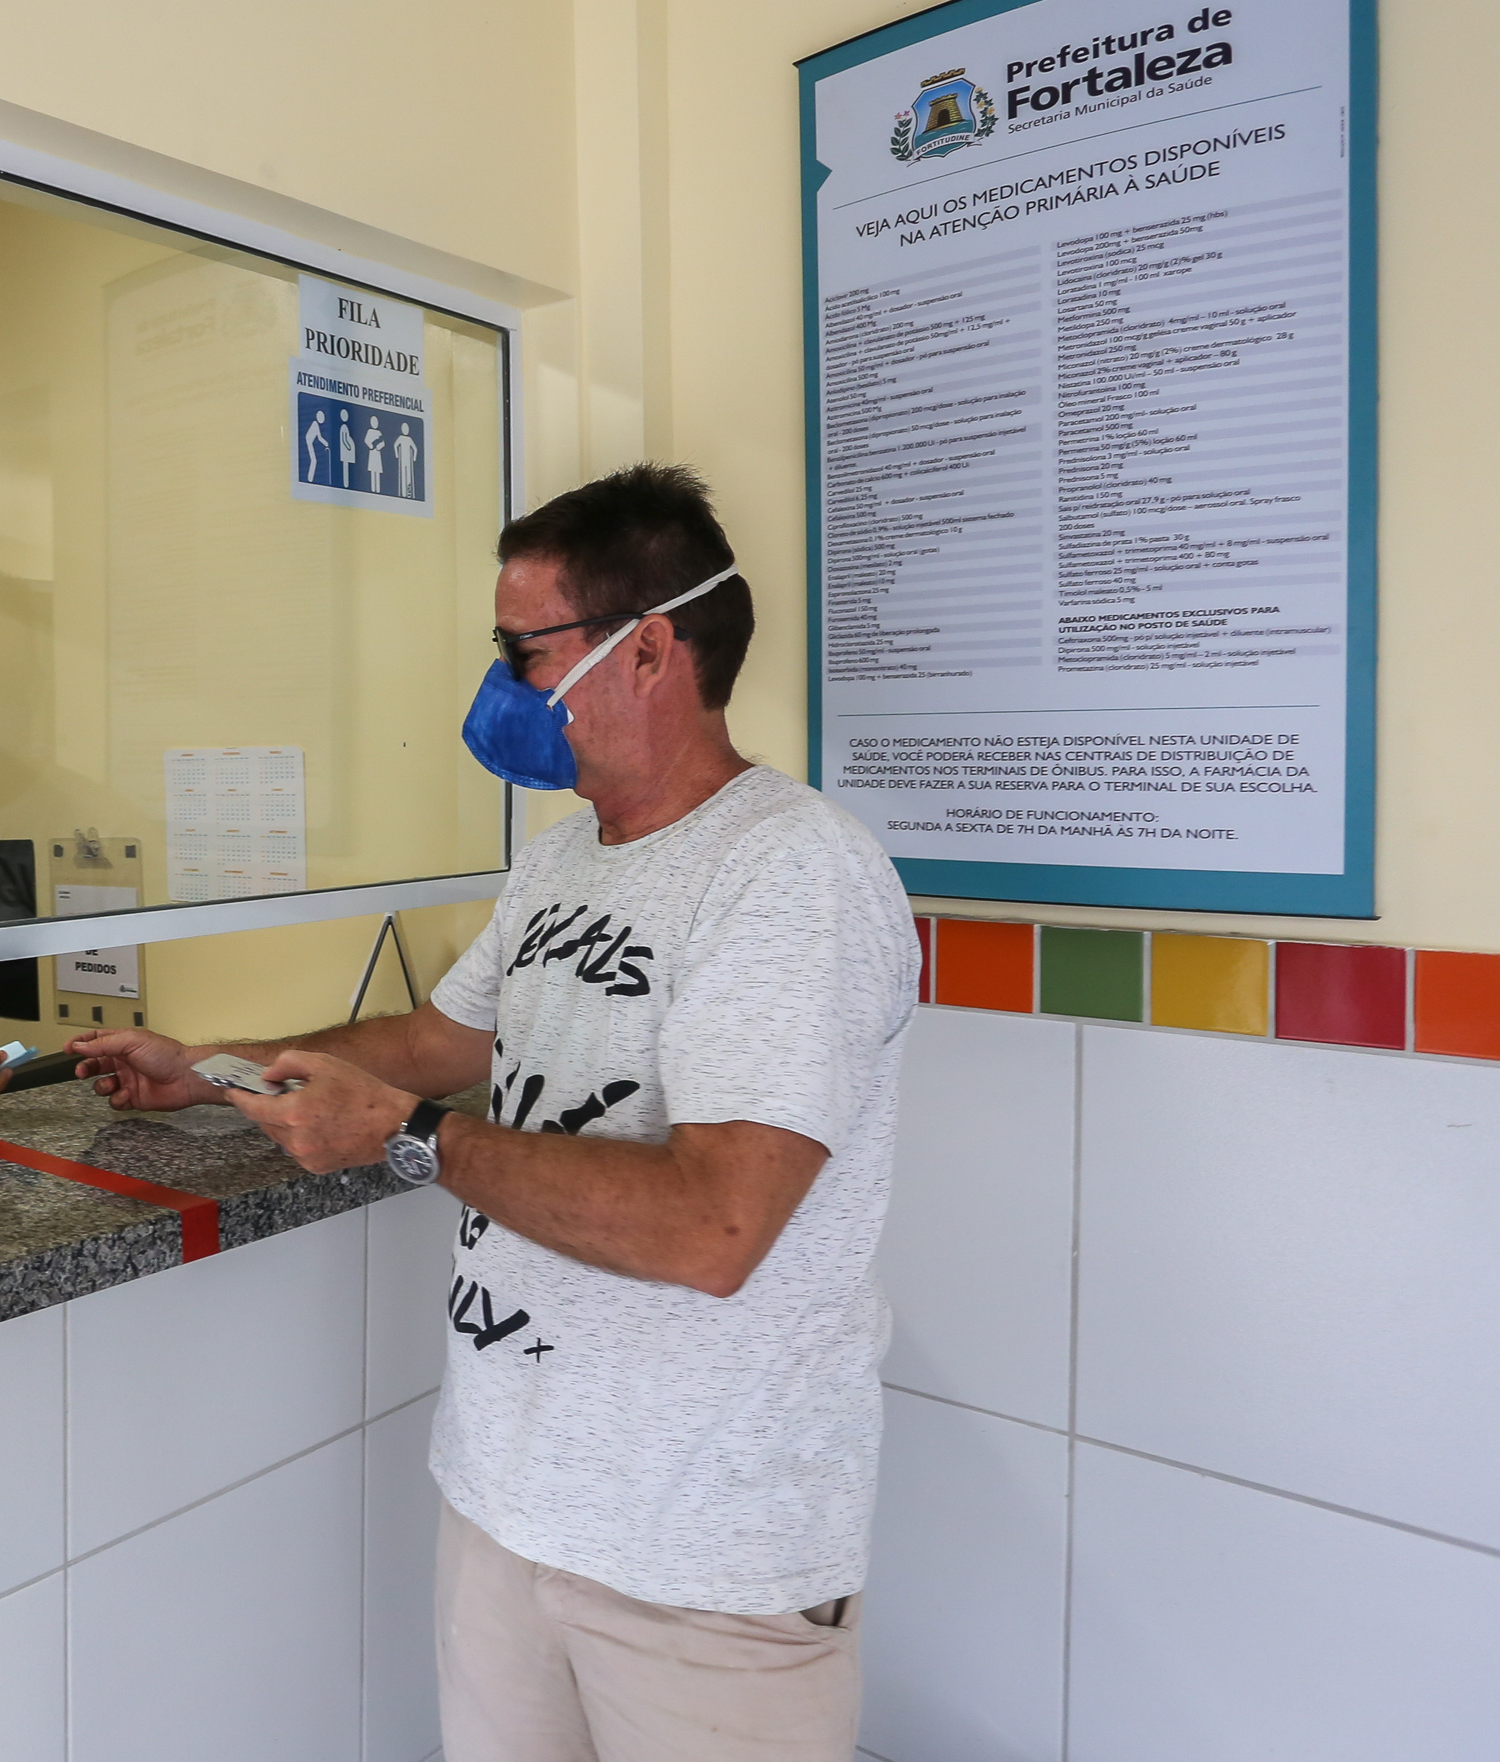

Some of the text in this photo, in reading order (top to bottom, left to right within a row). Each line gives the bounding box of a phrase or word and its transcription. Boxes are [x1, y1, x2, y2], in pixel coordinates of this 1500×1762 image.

[1007, 7, 1232, 83] Prefeitura de
[1008, 41, 1232, 120] Fortaleza
[1008, 75, 1212, 134] Secretaria Municipal da Saúde
[915, 134, 971, 156] FORTITUDINE
[856, 123, 1285, 237] VEJA AQUI OS MEDICAMENTOS DISPONÍVEIS
[900, 160, 1219, 247] NA ATENÇÃO PRIMÁRIA À SAÚDE
[337, 296, 381, 329] FILA
[304, 327, 420, 376] PRIORIDADE
[296, 370, 425, 413] ATENDIMENTO PREFERENCIAL
[1058, 615, 1096, 623] ABAIXO
[1098, 610, 1179, 621] MEDICAMENTOS
[1182, 607, 1248, 617] EXCLUSIVOS
[1058, 622, 1117, 633] UTILIZAÇÃO
[1119, 622, 1135, 630] NO
[1138, 621, 1172, 629] POSTO
[1191, 617, 1227, 627] SAÚDE
[849, 732, 1299, 749] CASO O MEDICAMENTO NÃO ESTEJA DISPONÍVEL NESTA UNIDADE DE
[892, 749, 923, 761] VOCÊ
[926, 749, 974, 761] PODERÁ
[977, 751, 1032, 761] RECEBER
[1035, 751, 1061, 761] NAS
[1065, 750, 1132, 761] CENTRAIS
[1136, 750, 1156, 761] DE
[1160, 750, 1267, 763] DISTRIBUIÇÃO
[1272, 750, 1294, 760] DE
[843, 765, 930, 775] MEDICAMENTOS
[933, 765, 958, 775] NOS
[961, 765, 1026, 775] TERMINAIS
[1030, 765, 1048, 775] DE
[1112, 766, 1147, 776] PARA
[1188, 766, 1200, 776] A
[1204, 766, 1282, 776] FARMÁCIA
[1286, 766, 1309, 776] DA
[838, 778, 885, 788] UNIDADE
[888, 779, 916, 789] DEVE
[919, 779, 954, 789] FAZER
[956, 780, 965, 789] A
[968, 780, 992, 789] SUA
[995, 780, 1048, 790] RESERVA
[1051, 780, 1085, 790] PARA
[1088, 781, 1100, 791] O
[1103, 781, 1177, 791] TERMINAL
[1181, 781, 1201, 792] DE
[1205, 781, 1235, 792] SUA
[946, 806, 1002, 819] HORÁRIO
[1006, 809, 1023, 819] DE
[887, 820, 942, 831] SEGUNDA
[944, 822, 953, 831] A
[955, 822, 993, 833] SEXTA
[996, 823, 1014, 833] DE
[1017, 824, 1033, 834] 7H
[1038, 824, 1057, 834] DA
[1060, 824, 1113, 836] MANHÃ
[1116, 824, 1133, 837] ÀS
[1137, 827, 1156, 837] 7H
[1160, 827, 1182, 838] DA
[75, 961, 117, 976] PEDIDOS
